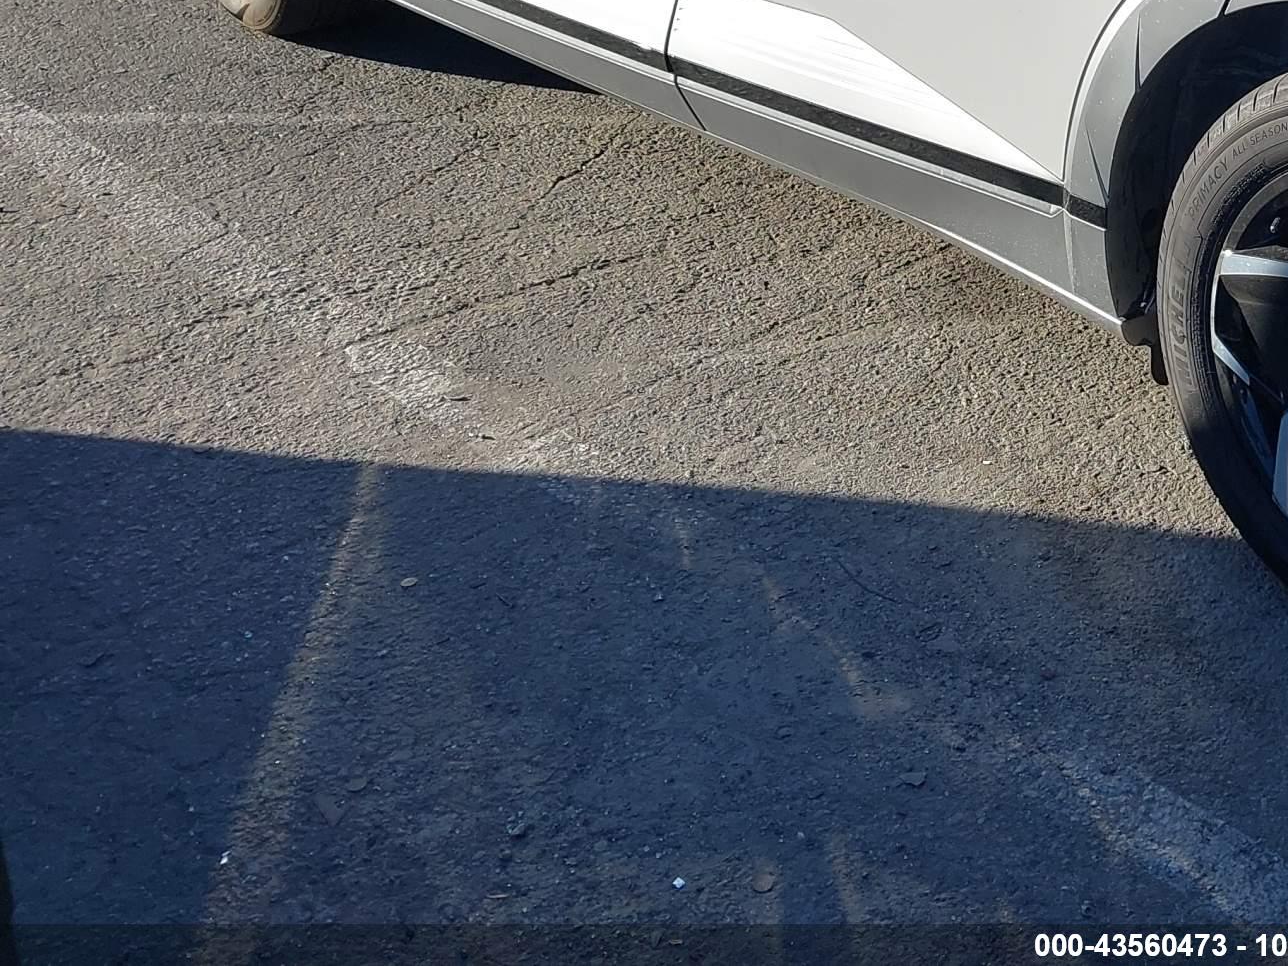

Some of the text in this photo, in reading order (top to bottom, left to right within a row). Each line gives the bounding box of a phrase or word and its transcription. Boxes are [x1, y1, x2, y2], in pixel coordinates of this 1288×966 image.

[1187, 122, 1288, 220] PRIMACY ALL SEASON
